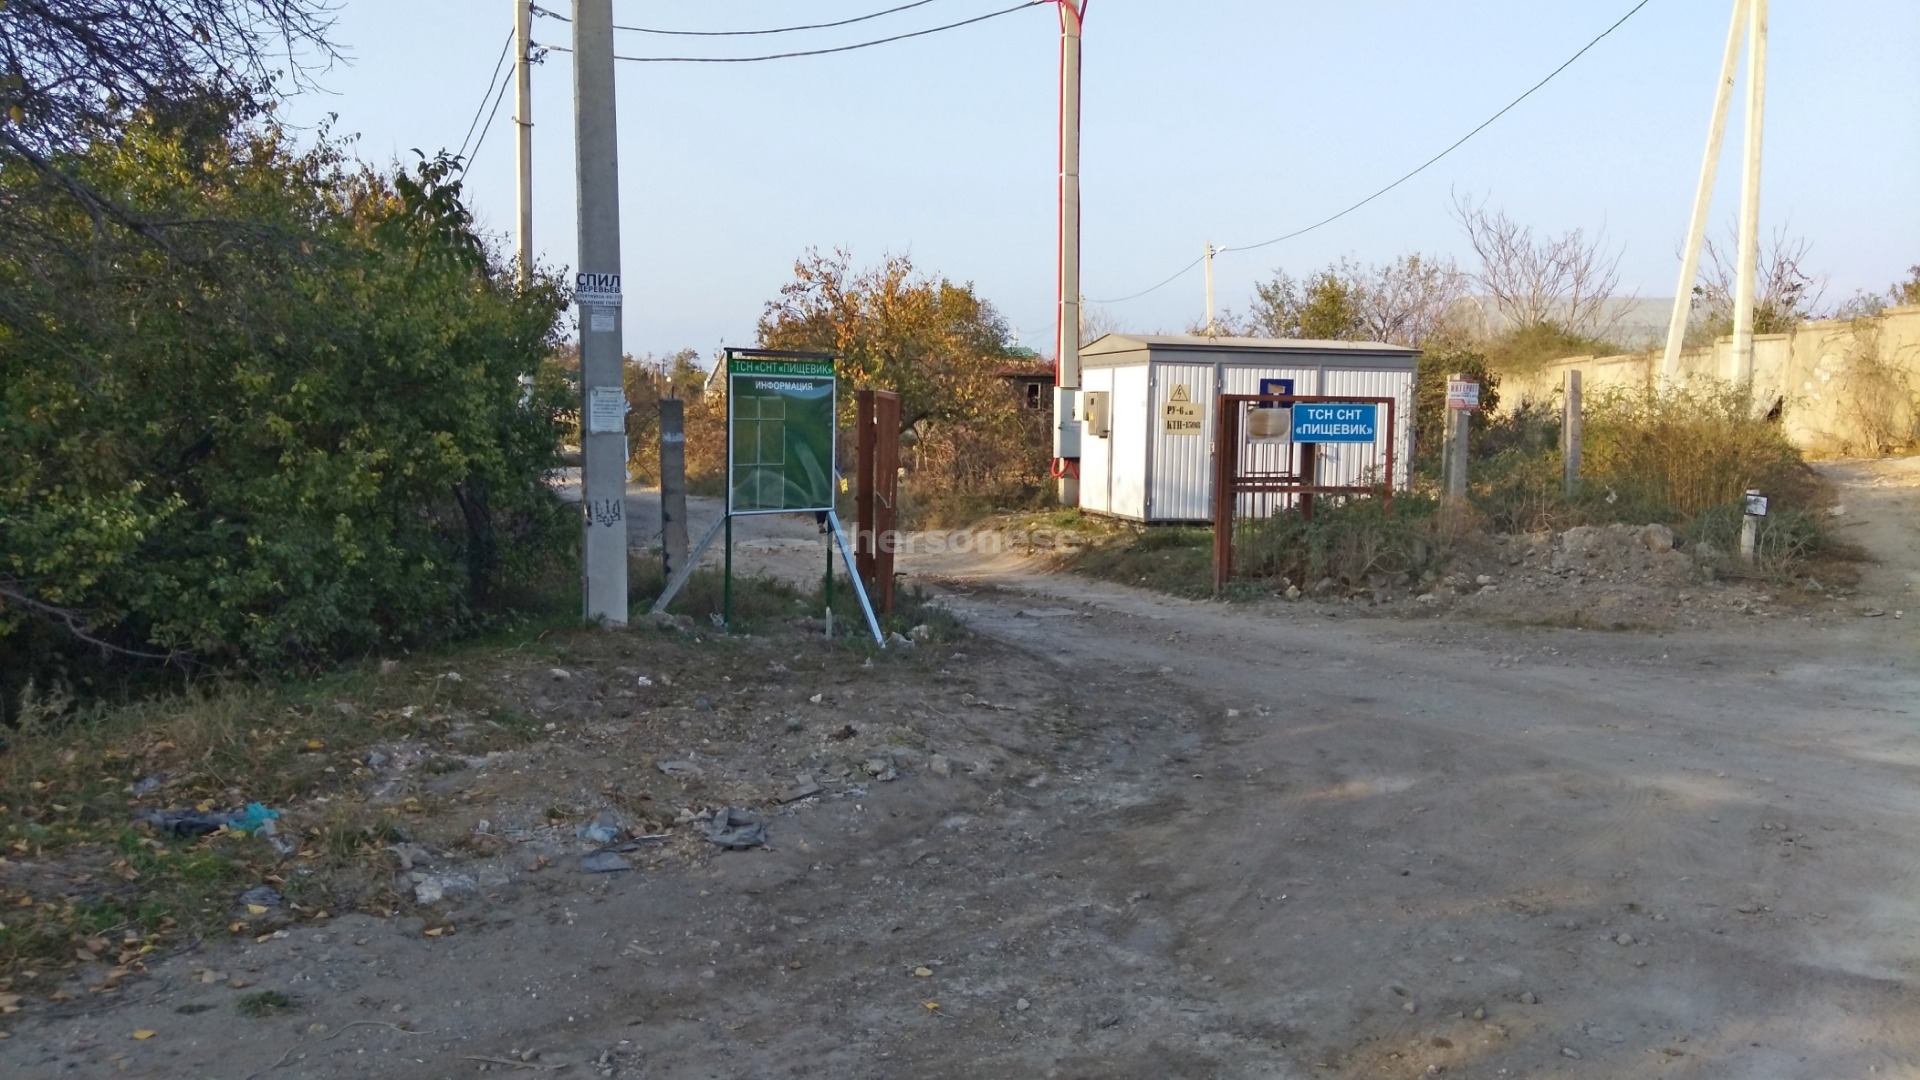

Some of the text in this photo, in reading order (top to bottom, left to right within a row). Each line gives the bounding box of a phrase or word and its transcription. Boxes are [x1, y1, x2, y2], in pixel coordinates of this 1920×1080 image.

[577, 273, 620, 287] СПИЛ
[735, 361, 832, 375] ТСН «СНТ «ПИЩЕВИК»
[755, 381, 813, 391] ИНФОРМАЦИЯ
[1307, 409, 1363, 420] ТСН СНТ
[1295, 423, 1373, 437] «ПИЩЕВИК»
